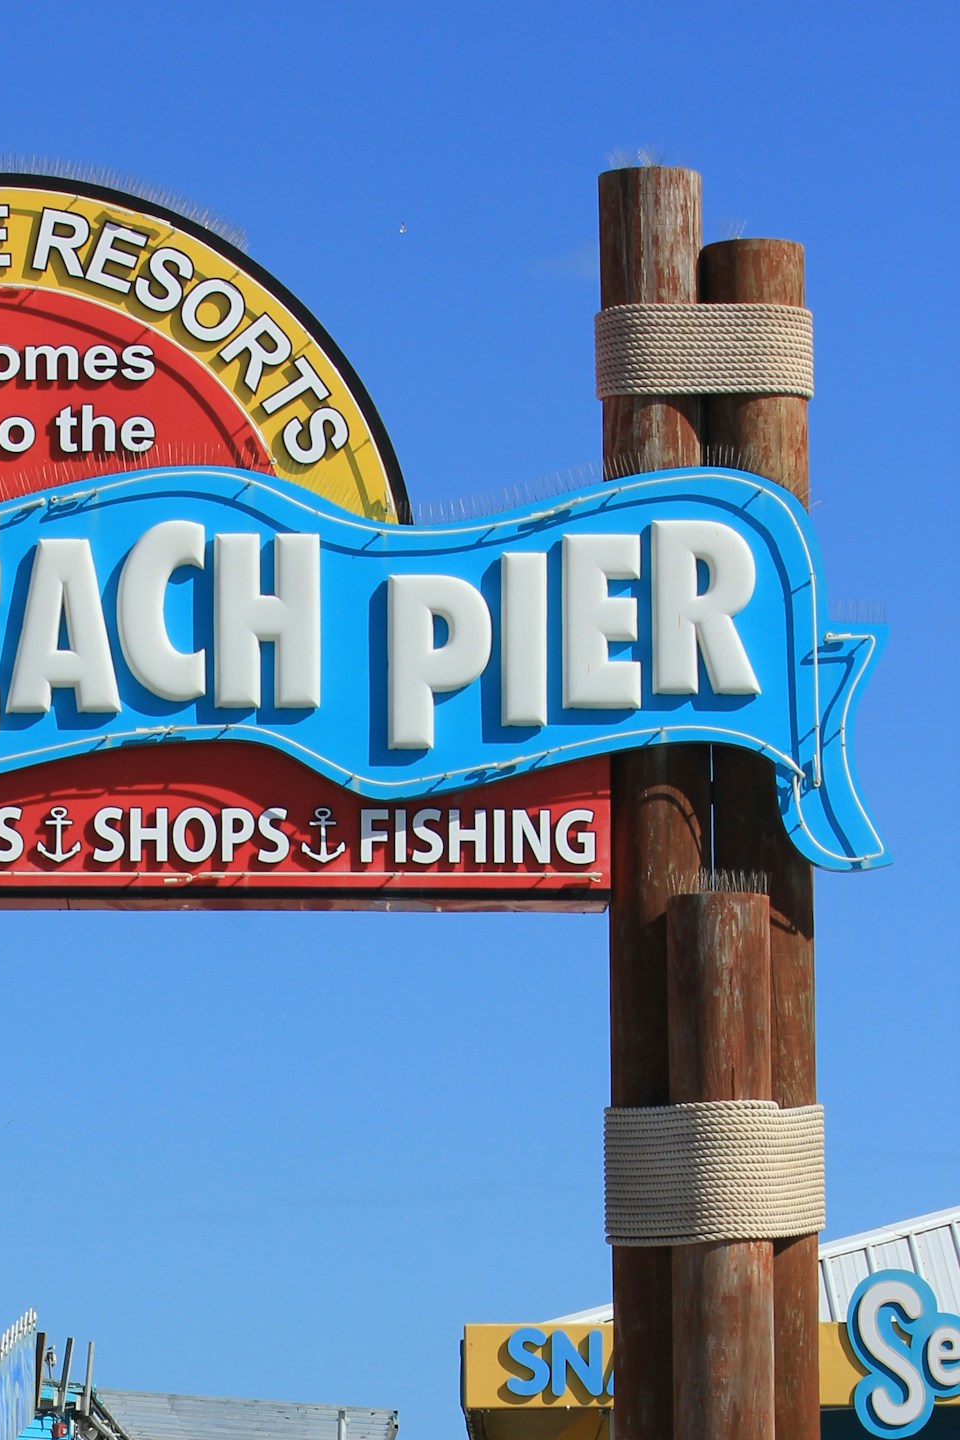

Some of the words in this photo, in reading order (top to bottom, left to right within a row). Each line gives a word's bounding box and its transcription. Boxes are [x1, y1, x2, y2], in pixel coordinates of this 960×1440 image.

[31, 206, 350, 465] RESORTS
[55, 404, 156, 453] the
[386, 519, 761, 751] PIER
[92, 806, 290, 865] SHOPS
[360, 808, 597, 865] FISHING
[505, 1327, 614, 1397] SN
